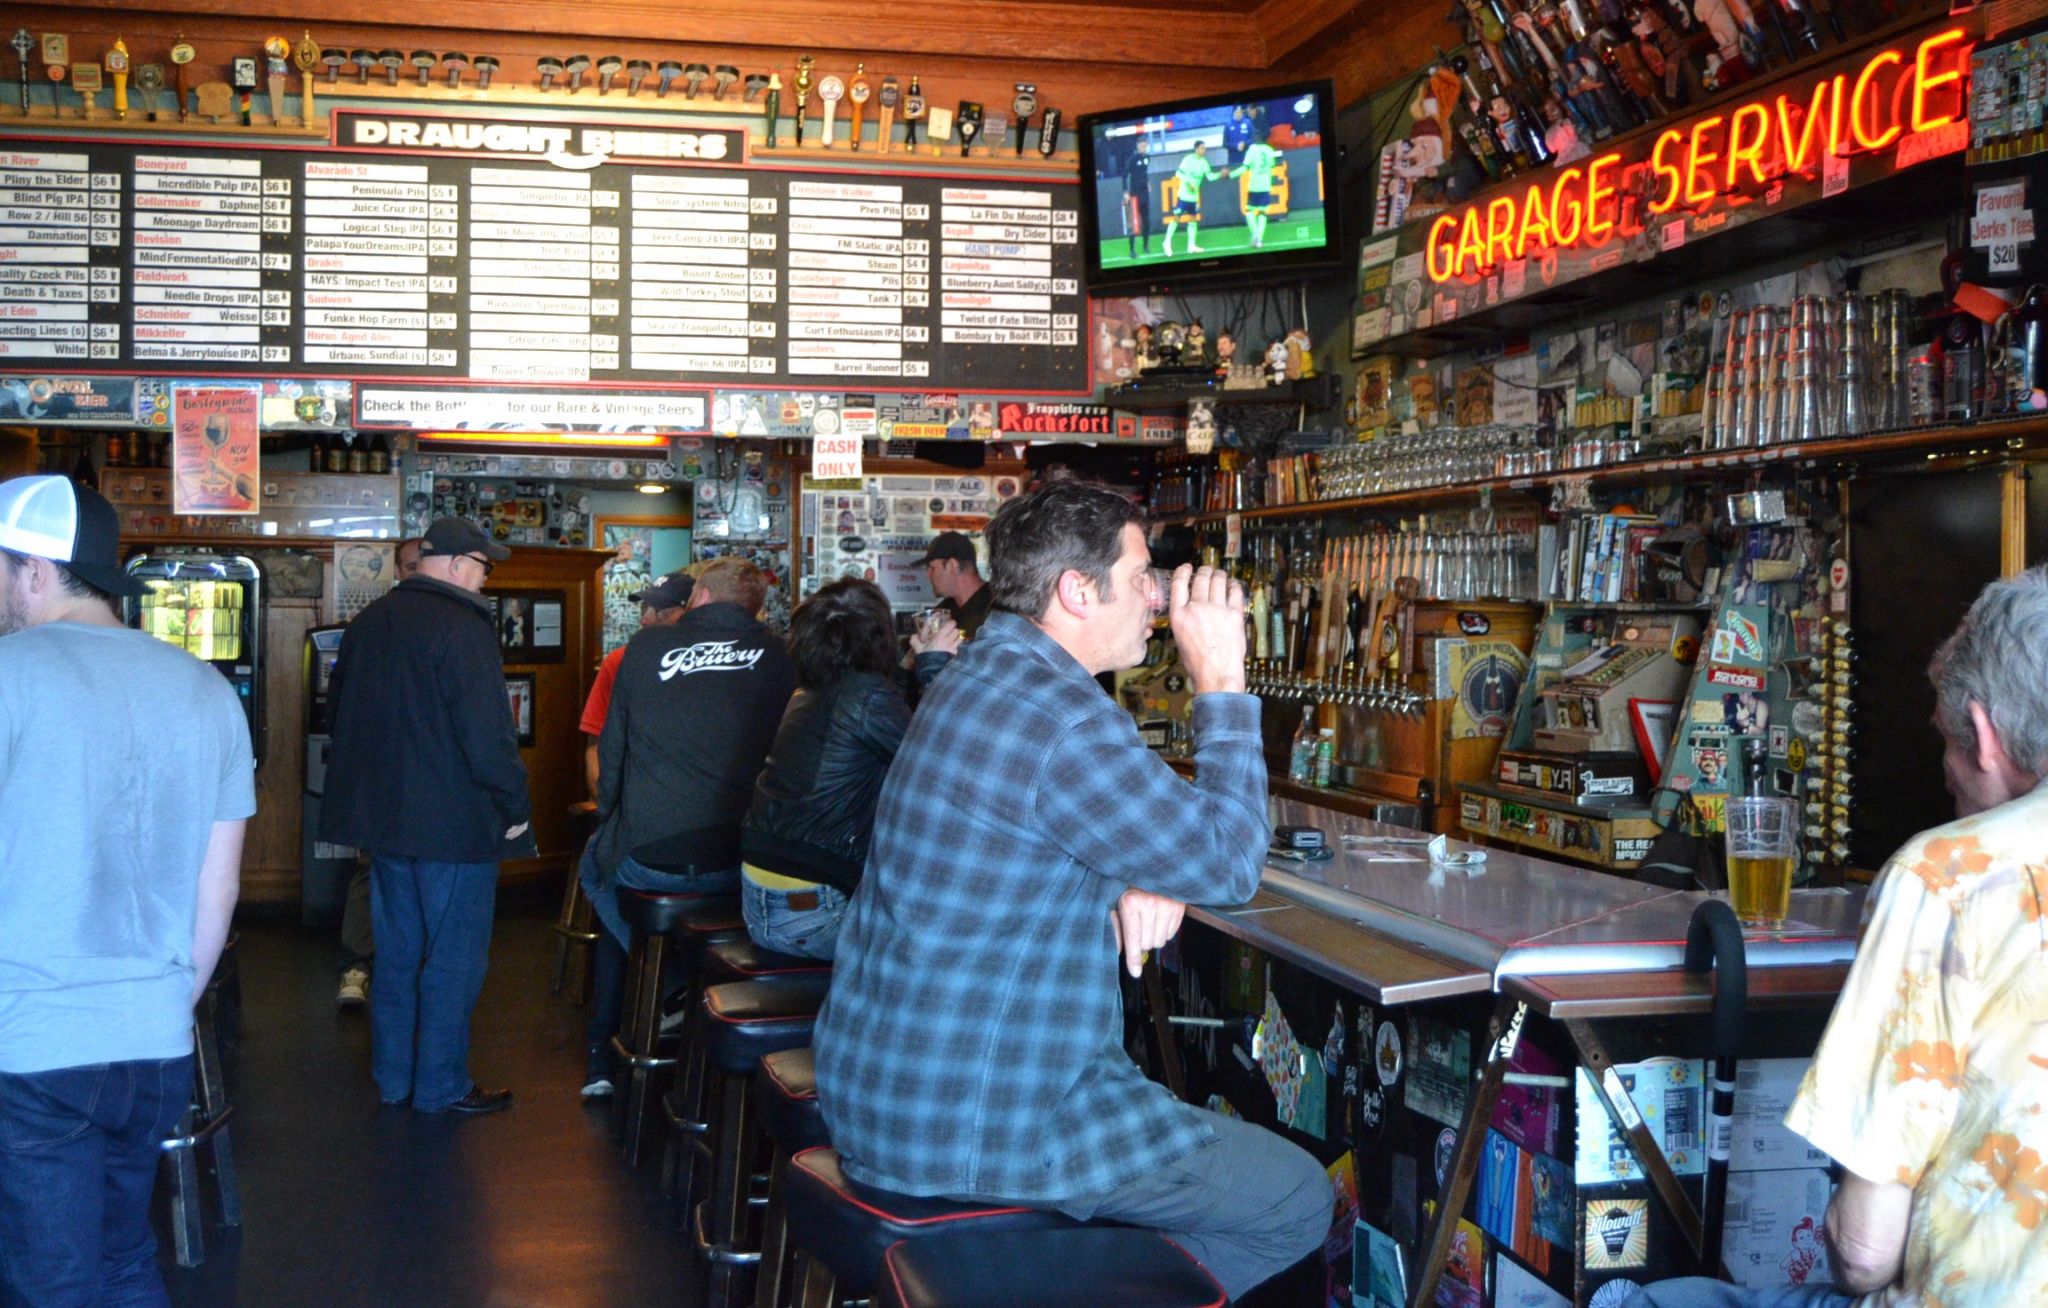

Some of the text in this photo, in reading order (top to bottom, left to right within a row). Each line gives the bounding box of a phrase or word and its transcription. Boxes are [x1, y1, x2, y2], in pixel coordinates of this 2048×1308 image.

[355, 120, 728, 160] DRAUGHT BEERS
[11, 155, 40, 165] River
[1426, 29, 1967, 284] GARAGE SERVICE
[135, 159, 188, 171] Boneyard
[307, 165, 353, 176] Alvarado
[4, 174, 108, 186] Pliny the Elder $6
[158, 179, 279, 192] Incredible Pulp IPA $6
[352, 185, 426, 196] Peninsula Pils
[14, 193, 107, 205] Blind Pig IPA $5
[136, 196, 278, 211] Cellarmaker Daphne $6
[723, 200, 748, 208] Nitro
[352, 203, 425, 214] Juice Cruz IPA
[860, 205, 918, 216] Pivo Pils $5
[8, 210, 32, 220] Row
[35, 212, 42, 220] 2
[53, 212, 71, 222] Hill
[73, 213, 88, 222] 56
[93, 213, 107, 224] $5
[971, 210, 1049, 222] La Fin Du Monde
[153, 217, 278, 230] Moonage Daydream $6
[342, 223, 426, 235] Logical Step IPA
[28, 230, 109, 242] Damnation $5
[1004, 229, 1047, 241] Dry Cider
[1972, 220, 2008, 241] Jerks
[135, 234, 182, 244] Revision
[837, 240, 918, 253] FM Static IPA $7
[965, 243, 1020, 255] HAND PUMP
[1993, 244, 2016, 265] $20
[264, 256, 278, 267] $7
[307, 257, 343, 267] Drakes
[867, 260, 898, 270] Steam
[945, 260, 991, 272] Lagunitas
[30, 269, 107, 280] Czeck Pils $5
[135, 271, 189, 282] Fieldwork
[714, 270, 746, 280] Amber
[311, 275, 426, 288] HAYS: Impact Test IPA
[882, 276, 918, 286] Pils $5
[947, 278, 1015, 290] Blueberry Aunt
[4, 286, 107, 300] Death & Taxes $5
[164, 290, 280, 305] Needle Drops $6
[720, 287, 746, 296] Stout
[307, 294, 353, 304] Sudwerk
[868, 294, 899, 303] Tank 7
[11, 307, 38, 316] Eden
[136, 309, 278, 321] Schneider Weisse $8
[323, 313, 408, 326] Funke Hop Farm
[960, 314, 1049, 326] Twist of Fate Bitter
[40, 326, 107, 338] Lines (s) $6
[135, 328, 187, 339] Mikkeller
[341, 332, 368, 342] Aged
[827, 327, 902, 337] Enthusiasm IPA
[955, 330, 1049, 343] Bombay by Boat IPA
[55, 344, 107, 357] White $6
[134, 347, 278, 360] Belma & Jerrylouise IPA $7
[369, 351, 408, 360] Sundial
[834, 363, 917, 373] Barrel Runner $5
[363, 399, 406, 412] Check
[409, 399, 432, 412] the
[507, 401, 526, 413] for
[530, 403, 552, 413] our
[556, 402, 588, 414] Rare
[591, 403, 601, 414] &
[658, 404, 695, 416] Beers
[1001, 402, 1111, 433] Rochefort
[816, 440, 858, 454] CASH
[817, 461, 857, 477] ONLY
[959, 481, 981, 490] ALE
[658, 646, 765, 682] Bruery
[1615, 839, 1634, 850] THE
